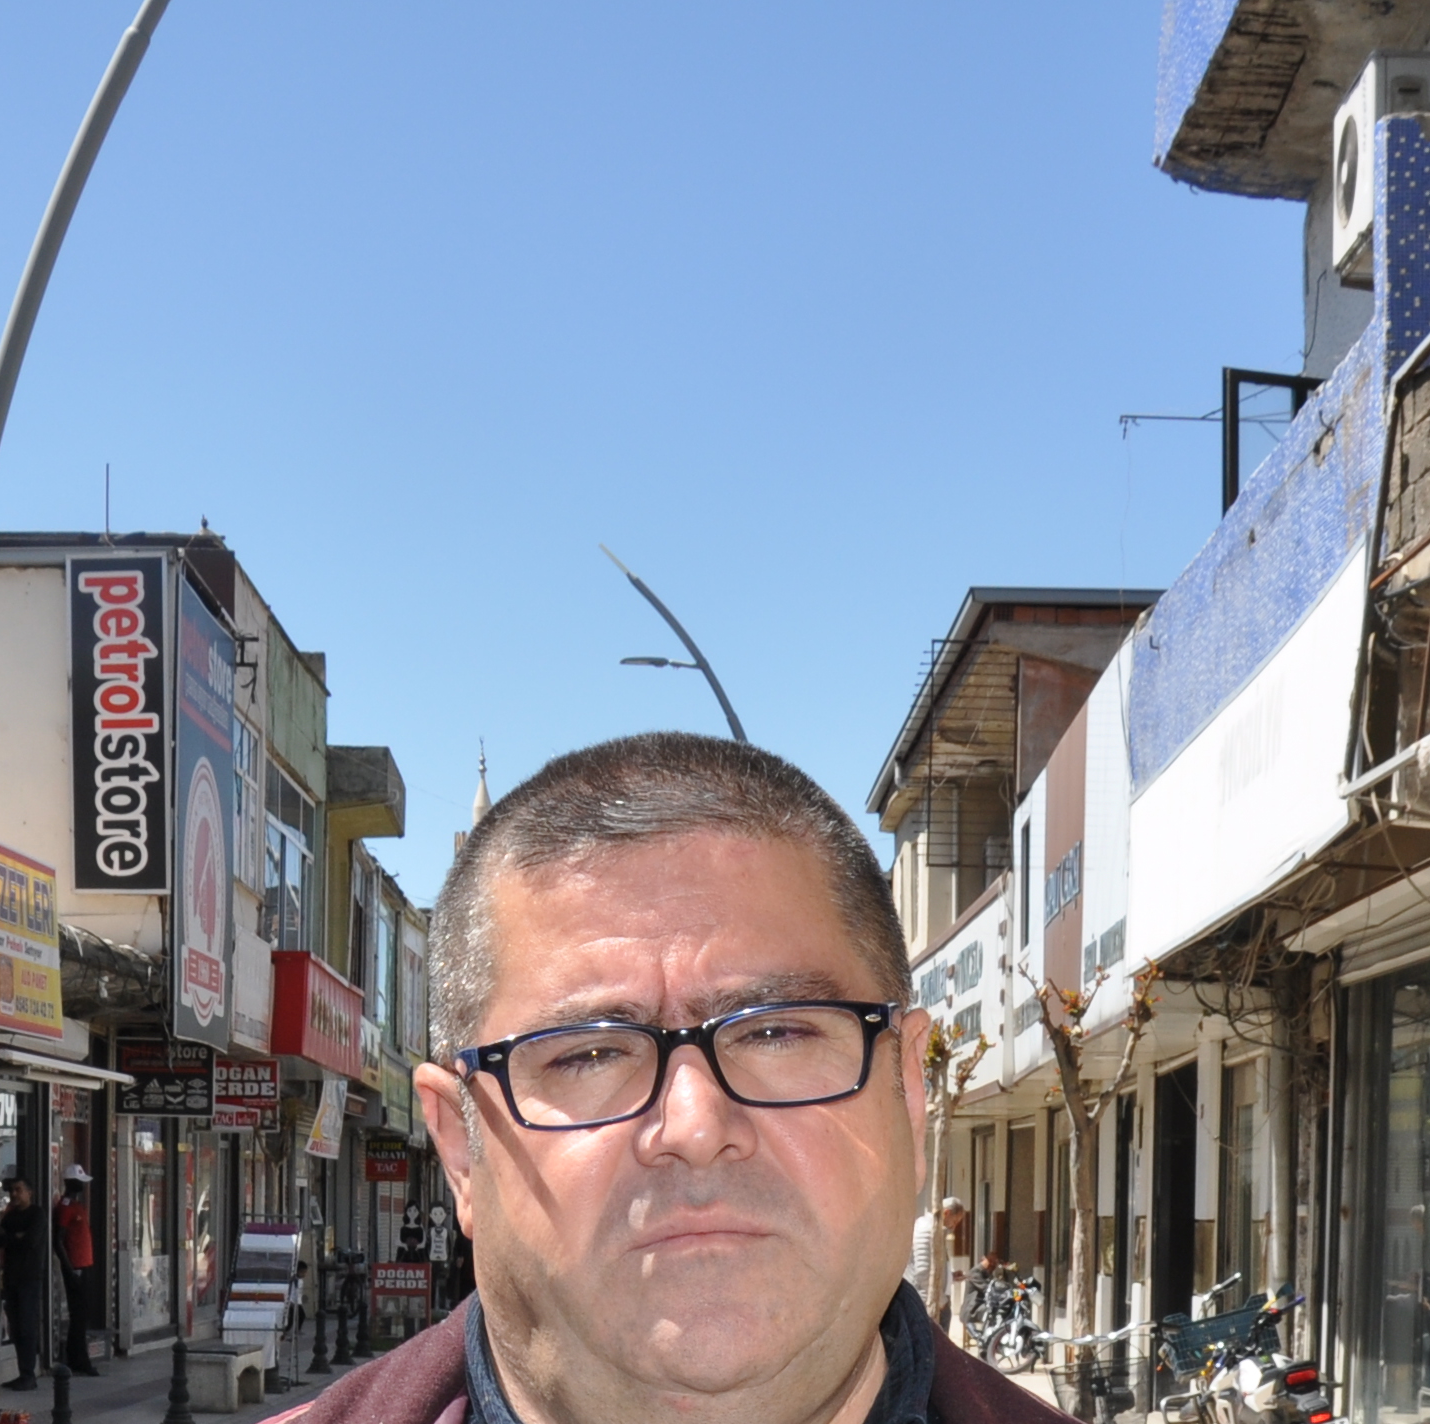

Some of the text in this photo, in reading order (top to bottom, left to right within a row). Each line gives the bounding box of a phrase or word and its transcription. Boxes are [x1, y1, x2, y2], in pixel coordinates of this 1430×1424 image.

[78, 571, 160, 876] petrolstore
[215, 1082, 276, 1096] ERDE
[376, 1267, 425, 1279] DOĞAN
[374, 1279, 428, 1289] PERDE
